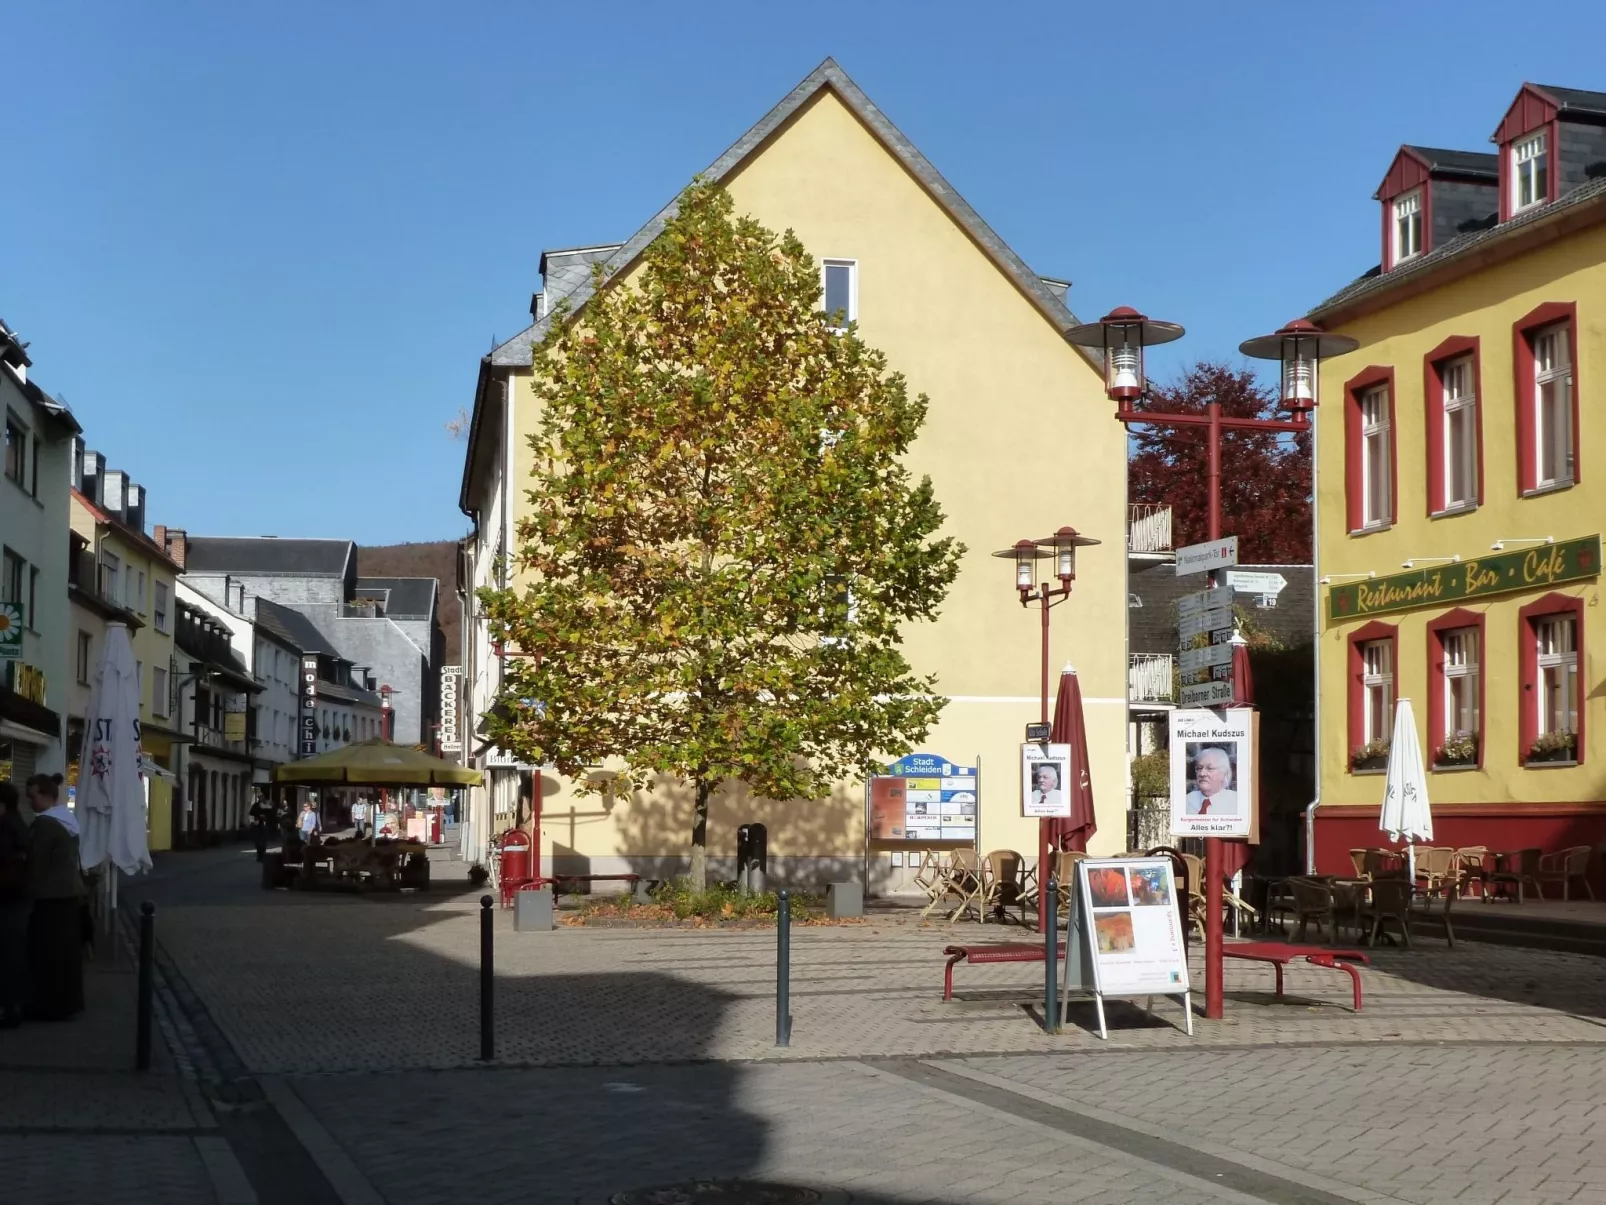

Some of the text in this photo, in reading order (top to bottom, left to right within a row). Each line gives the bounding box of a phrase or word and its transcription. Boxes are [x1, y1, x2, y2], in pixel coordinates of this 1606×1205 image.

[1357, 546, 1567, 611] Restaurant Bar Café
[304, 660, 317, 708] mode
[1182, 684, 1231, 704] Dreiborner Straße
[1177, 730, 1245, 738] Michael Kudszus
[913, 758, 934, 766] Stadt
